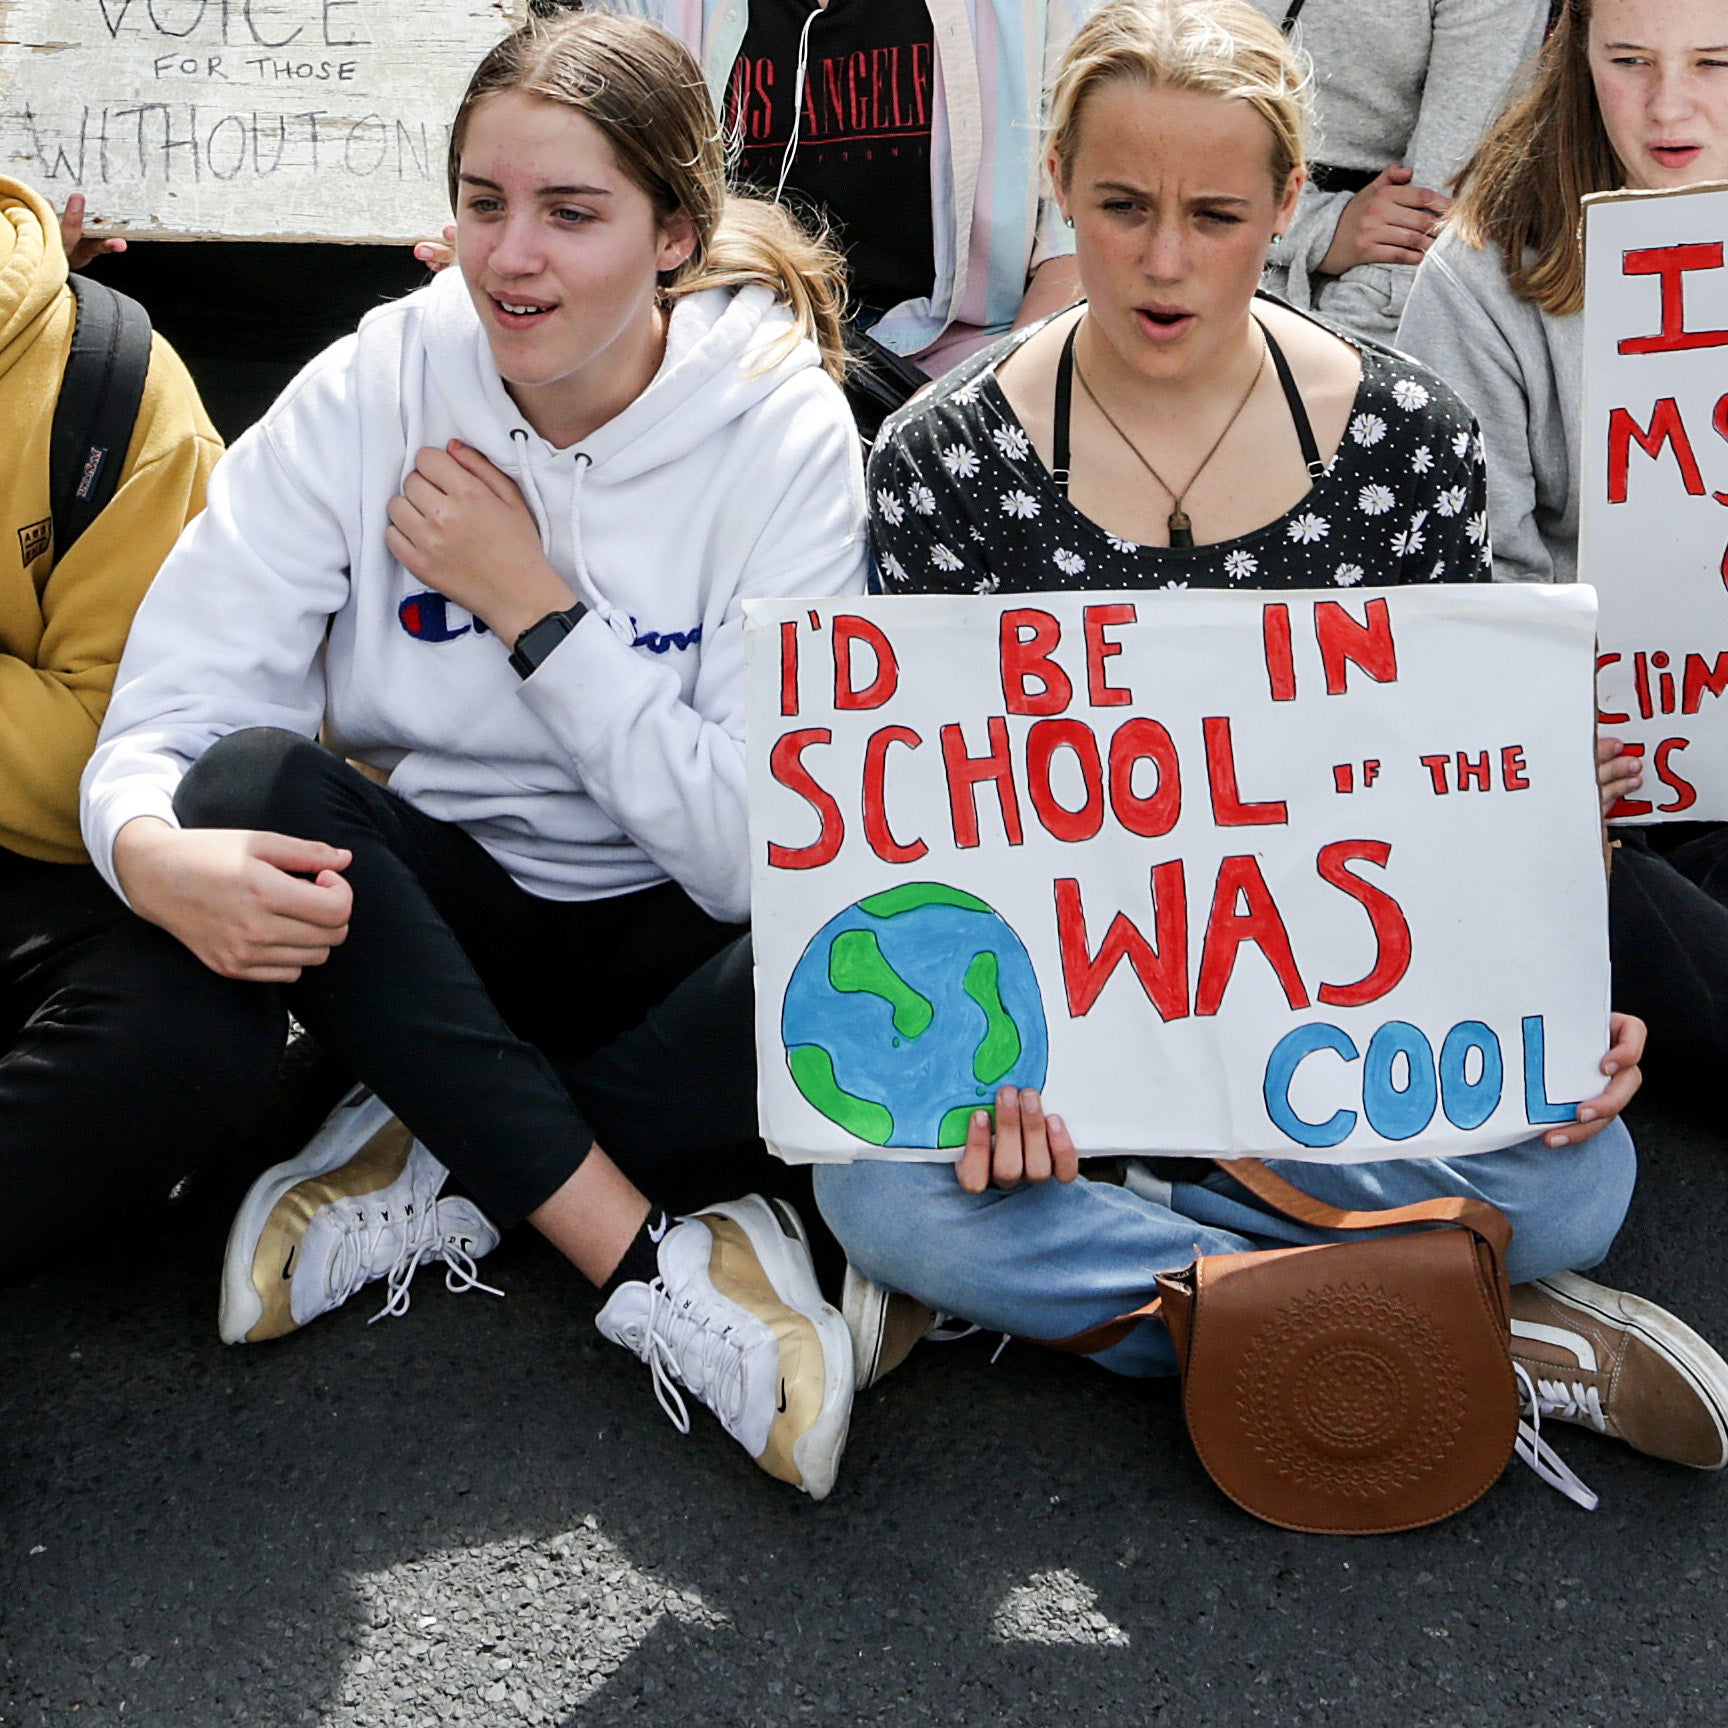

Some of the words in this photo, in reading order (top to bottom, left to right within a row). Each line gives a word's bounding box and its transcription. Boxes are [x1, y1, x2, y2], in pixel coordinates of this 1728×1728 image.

[154, 52, 230, 80] FOR
[245, 58, 357, 82] THOSE
[25, 101, 329, 186] WITHOUT
[778, 606, 899, 716] I'D
[998, 602, 1137, 717] BE
[1261, 597, 1398, 702] IN
[766, 716, 1289, 870] SCHOOL
[1332, 759, 1380, 795] IF
[1420, 744, 1532, 796] THE
[1053, 839, 1412, 1023] WAS
[1263, 1014, 1582, 1149] COOL
